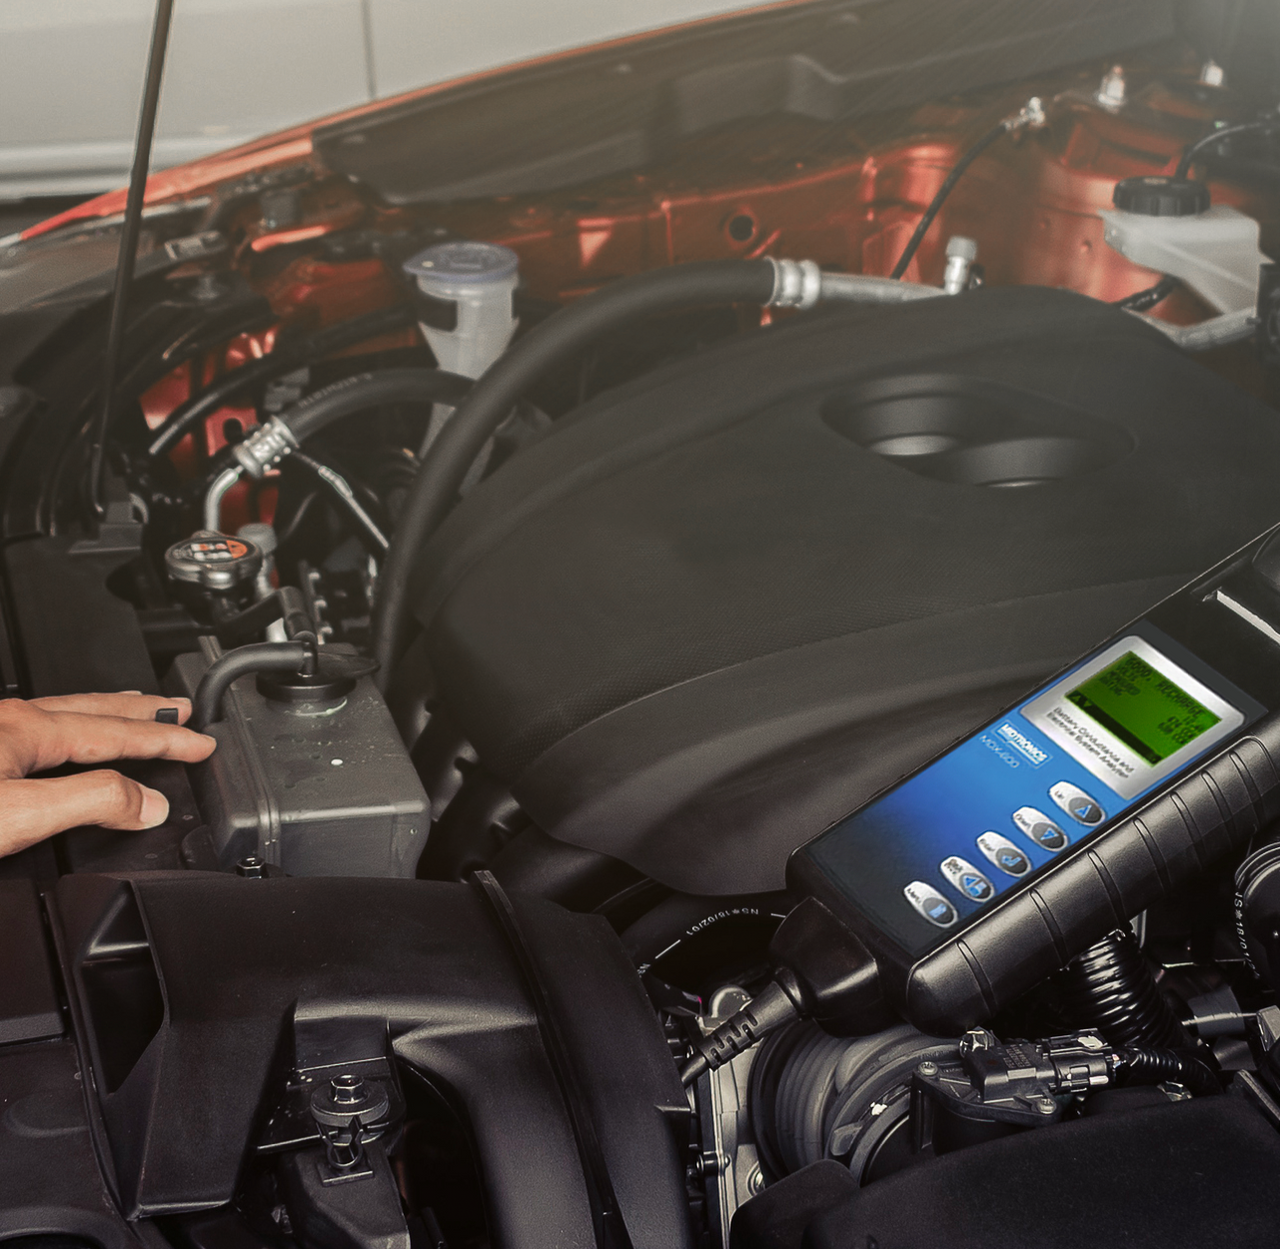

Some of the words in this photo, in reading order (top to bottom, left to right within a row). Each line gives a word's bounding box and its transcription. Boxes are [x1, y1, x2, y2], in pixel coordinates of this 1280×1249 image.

[1154, 680, 1206, 719] RECHARGE
[999, 723, 1049, 761] MIDTRONICS
[1075, 735, 1100, 757] System
[1118, 758, 1134, 773] and
